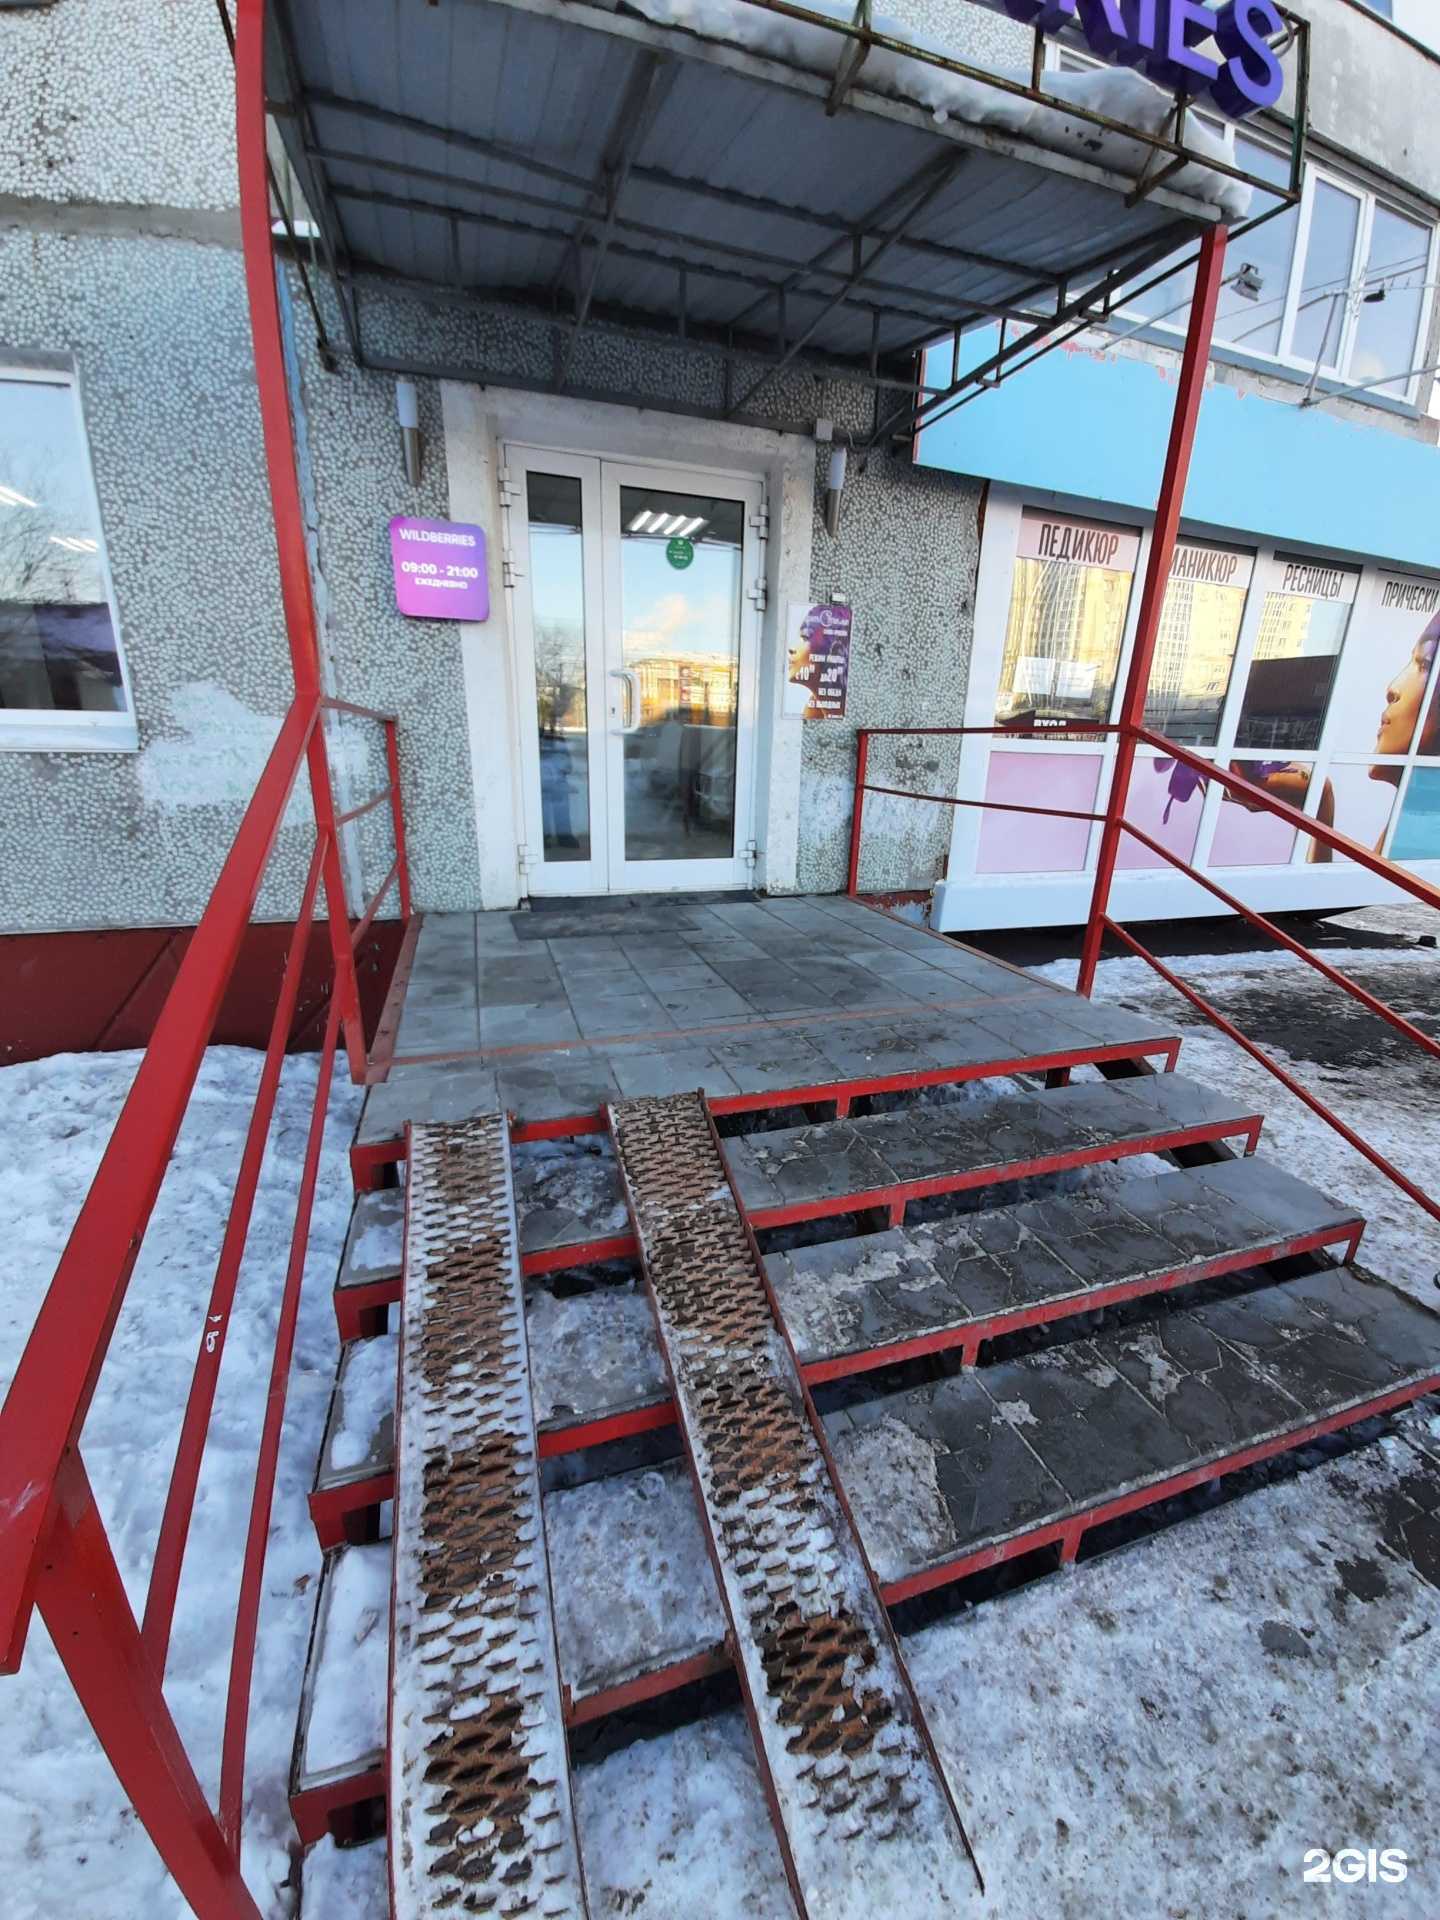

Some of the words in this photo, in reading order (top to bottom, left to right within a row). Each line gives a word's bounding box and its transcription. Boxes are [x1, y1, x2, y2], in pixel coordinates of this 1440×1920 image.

[399, 528, 476, 547] WILDBERRIES
[1038, 523, 1119, 565] ПЕДИКЮР
[401, 561, 438, 575] 09:00
[446, 565, 479, 578] 21:00
[1282, 564, 1345, 598] РЕСНИЦЫ
